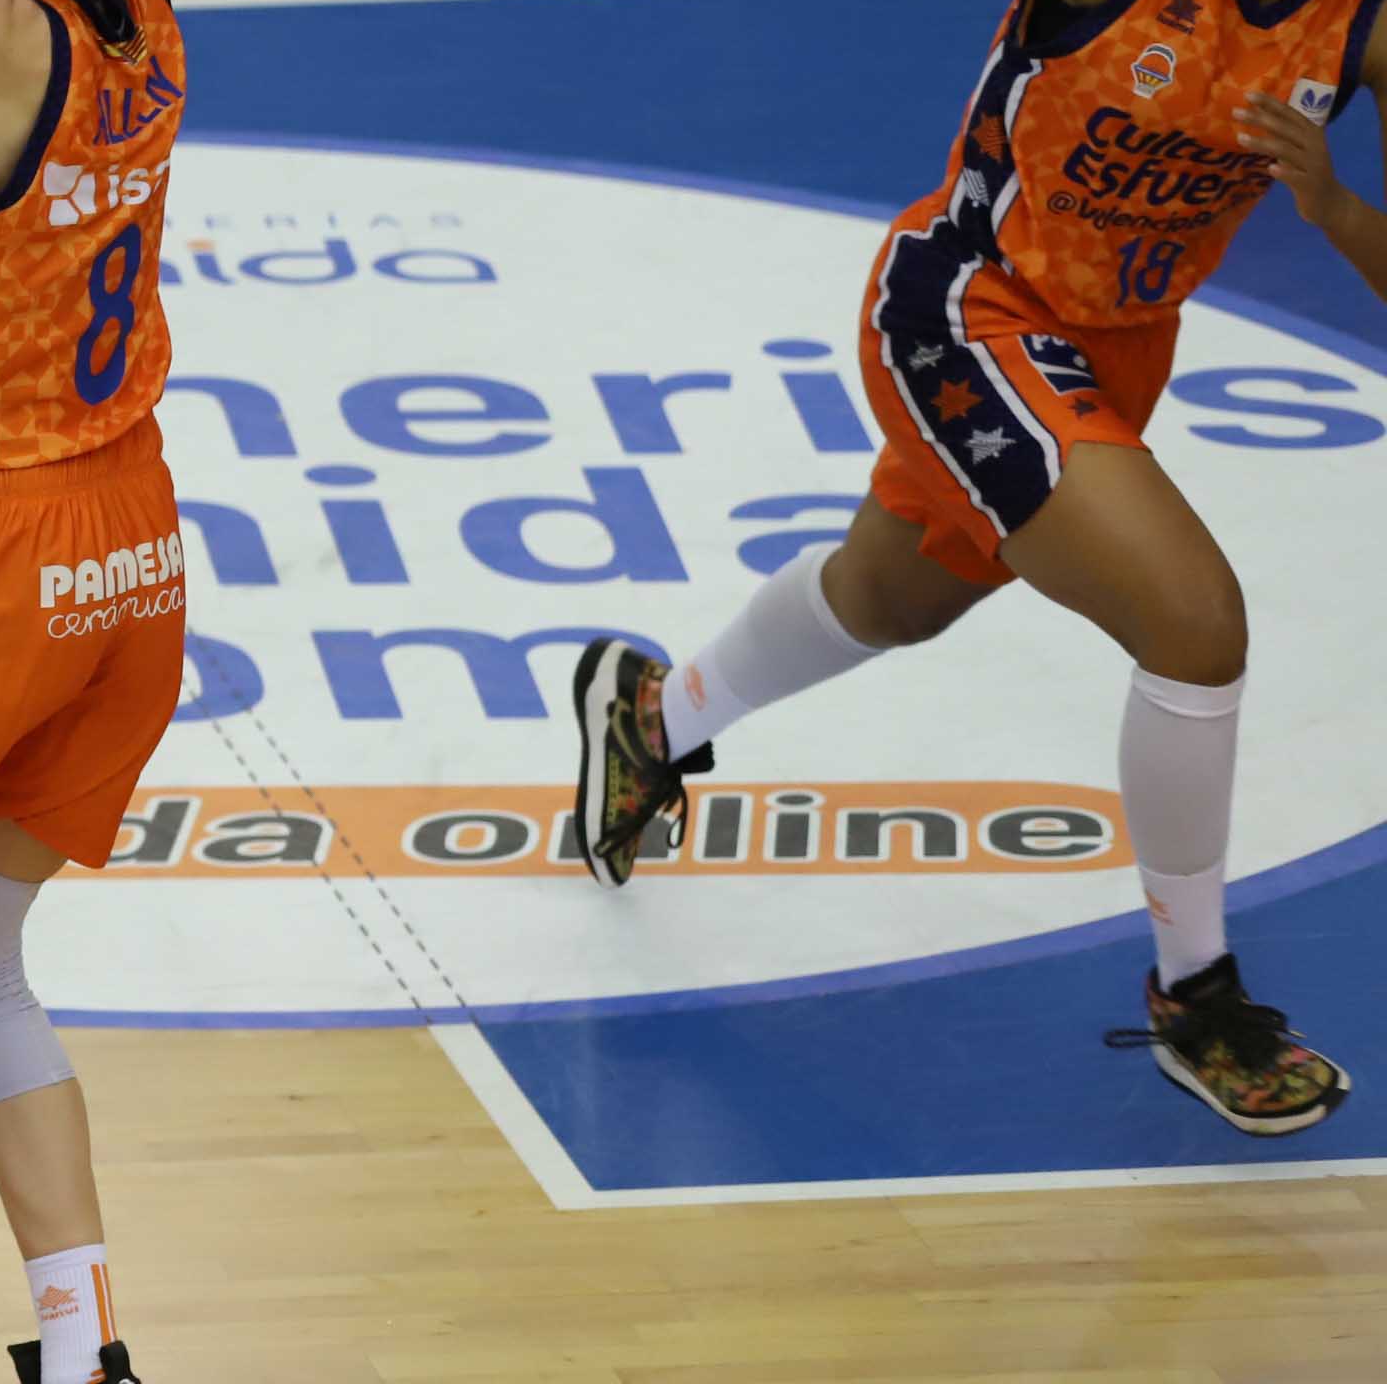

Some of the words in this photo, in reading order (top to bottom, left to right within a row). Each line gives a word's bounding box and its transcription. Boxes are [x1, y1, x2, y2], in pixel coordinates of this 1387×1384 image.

[1115, 236, 1185, 308] 18
[74, 224, 141, 406] 8
[40, 531, 184, 609] PAMESA
